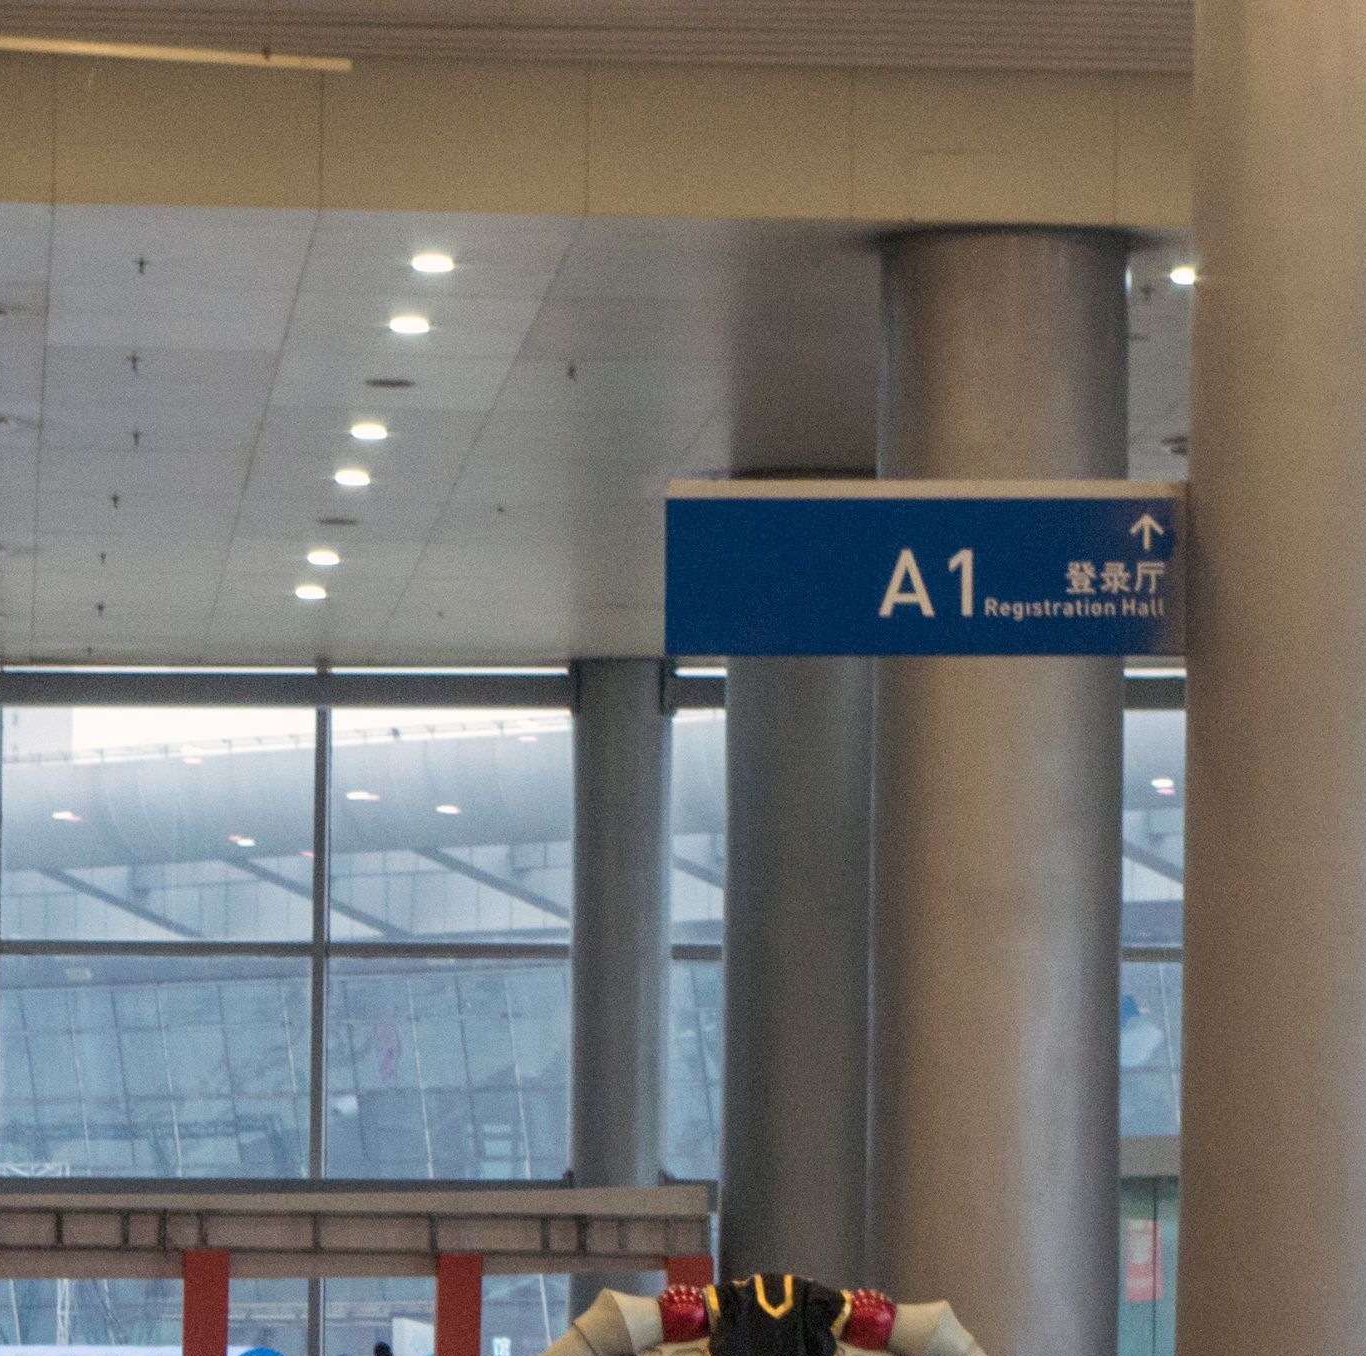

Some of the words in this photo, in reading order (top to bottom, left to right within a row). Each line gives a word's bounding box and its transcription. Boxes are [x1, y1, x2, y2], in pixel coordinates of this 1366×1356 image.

[878, 547, 975, 618] A1
[1065, 560, 1166, 595] 登录厅
[983, 597, 1116, 622] Registration
[1121, 597, 1166, 618] Hall
